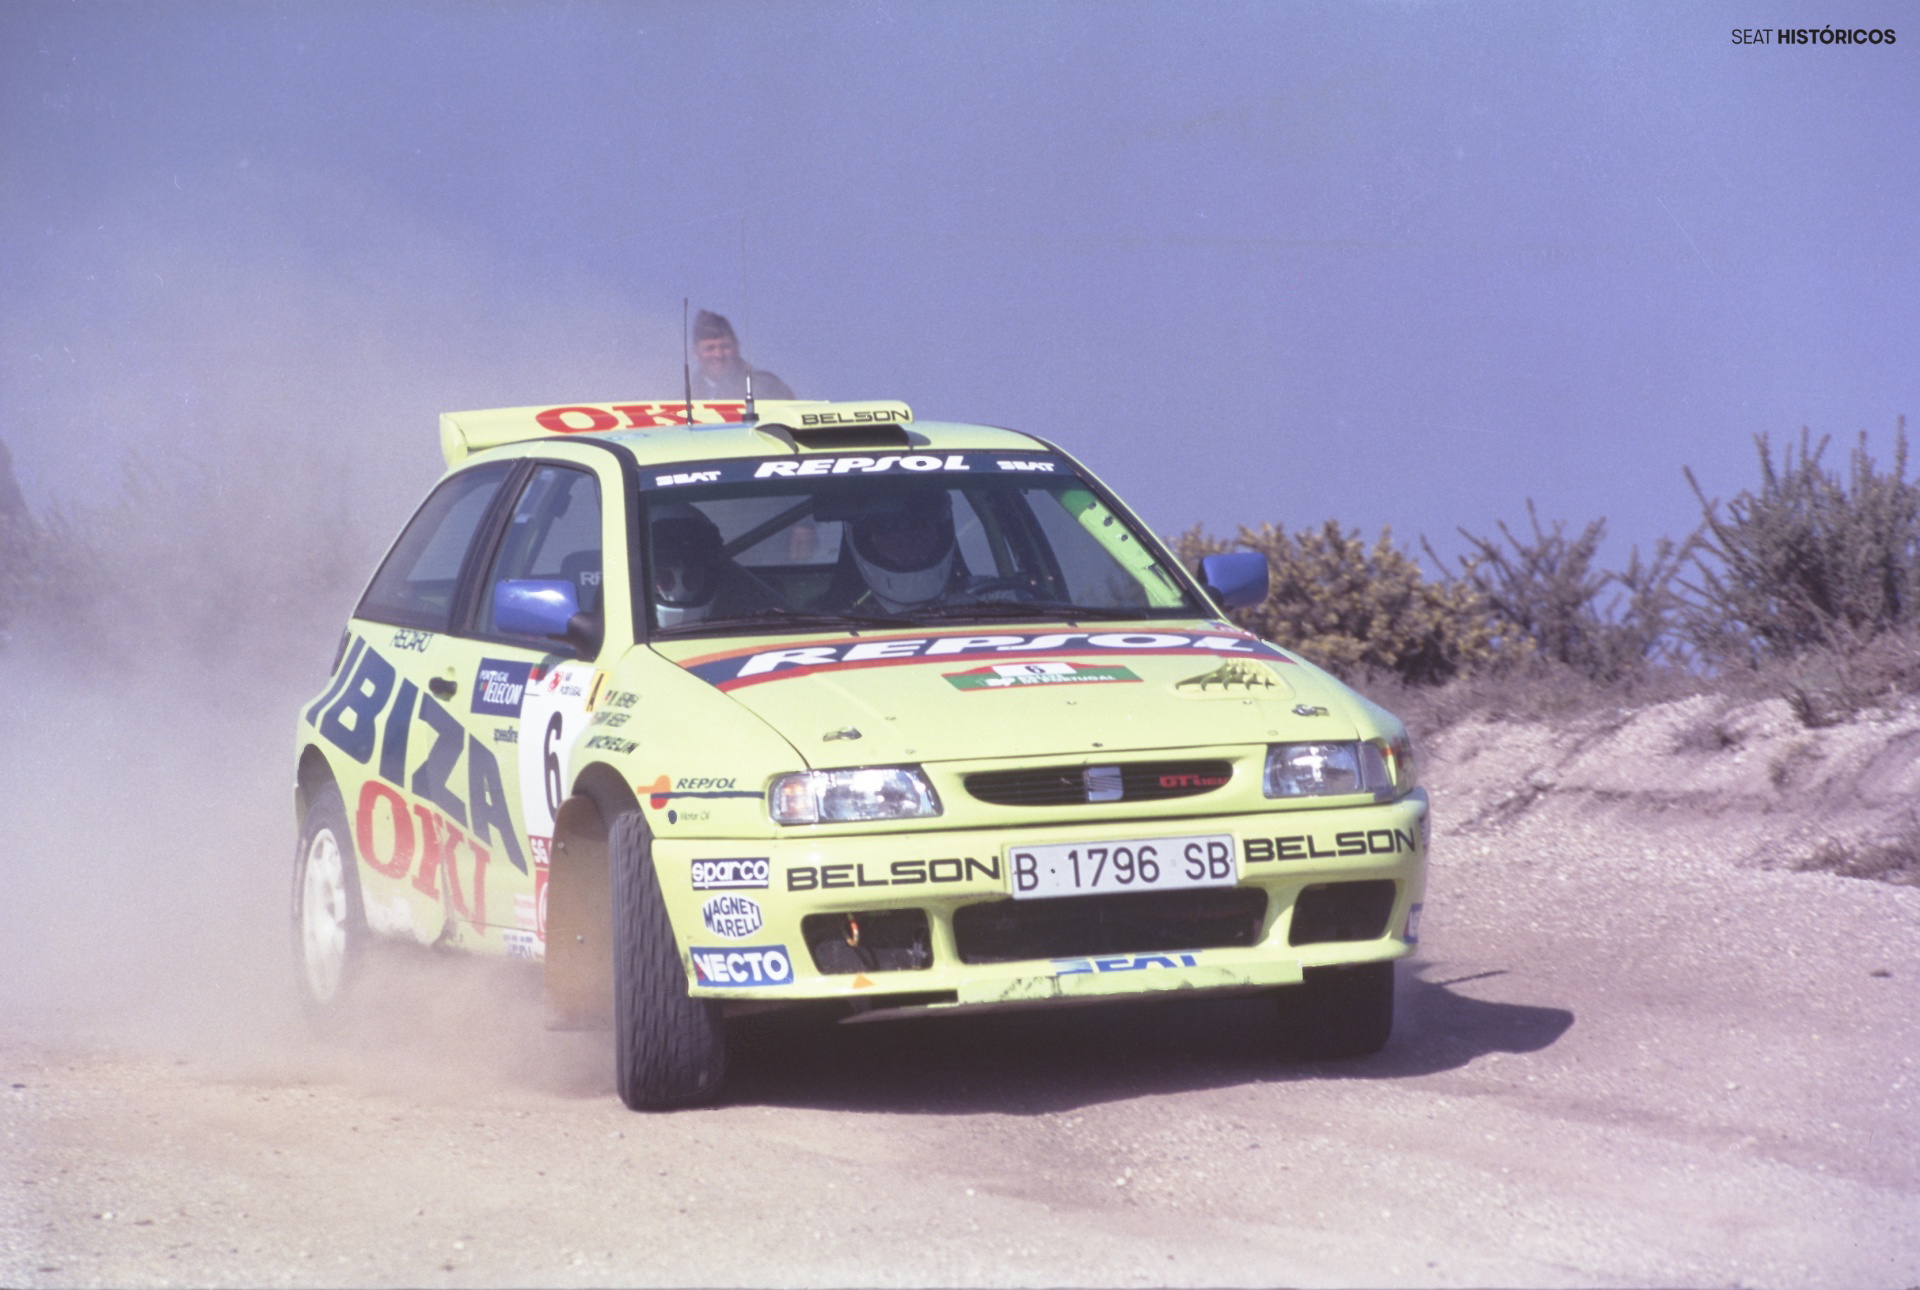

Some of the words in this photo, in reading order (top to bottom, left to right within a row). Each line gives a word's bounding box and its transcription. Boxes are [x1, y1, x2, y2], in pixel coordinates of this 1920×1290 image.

[535, 403, 746, 433] OKI
[801, 410, 910, 426] BELSON
[655, 471, 721, 486] SEAT
[754, 455, 970, 478] REPSOL
[996, 460, 1055, 472] SEAT
[736, 632, 1254, 678] REPSOL
[483, 671, 523, 705] TELECOM
[306, 635, 528, 877] IBIZA
[543, 711, 563, 825] 6
[676, 778, 737, 789] REPSOL
[356, 781, 491, 937] OKI
[1242, 828, 1416, 863] BELSON
[692, 860, 769, 888] sparco
[786, 856, 1001, 892] BELSON
[1014, 853, 1039, 891] B
[1067, 845, 1161, 888] 1796
[1183, 840, 1231, 880] SB
